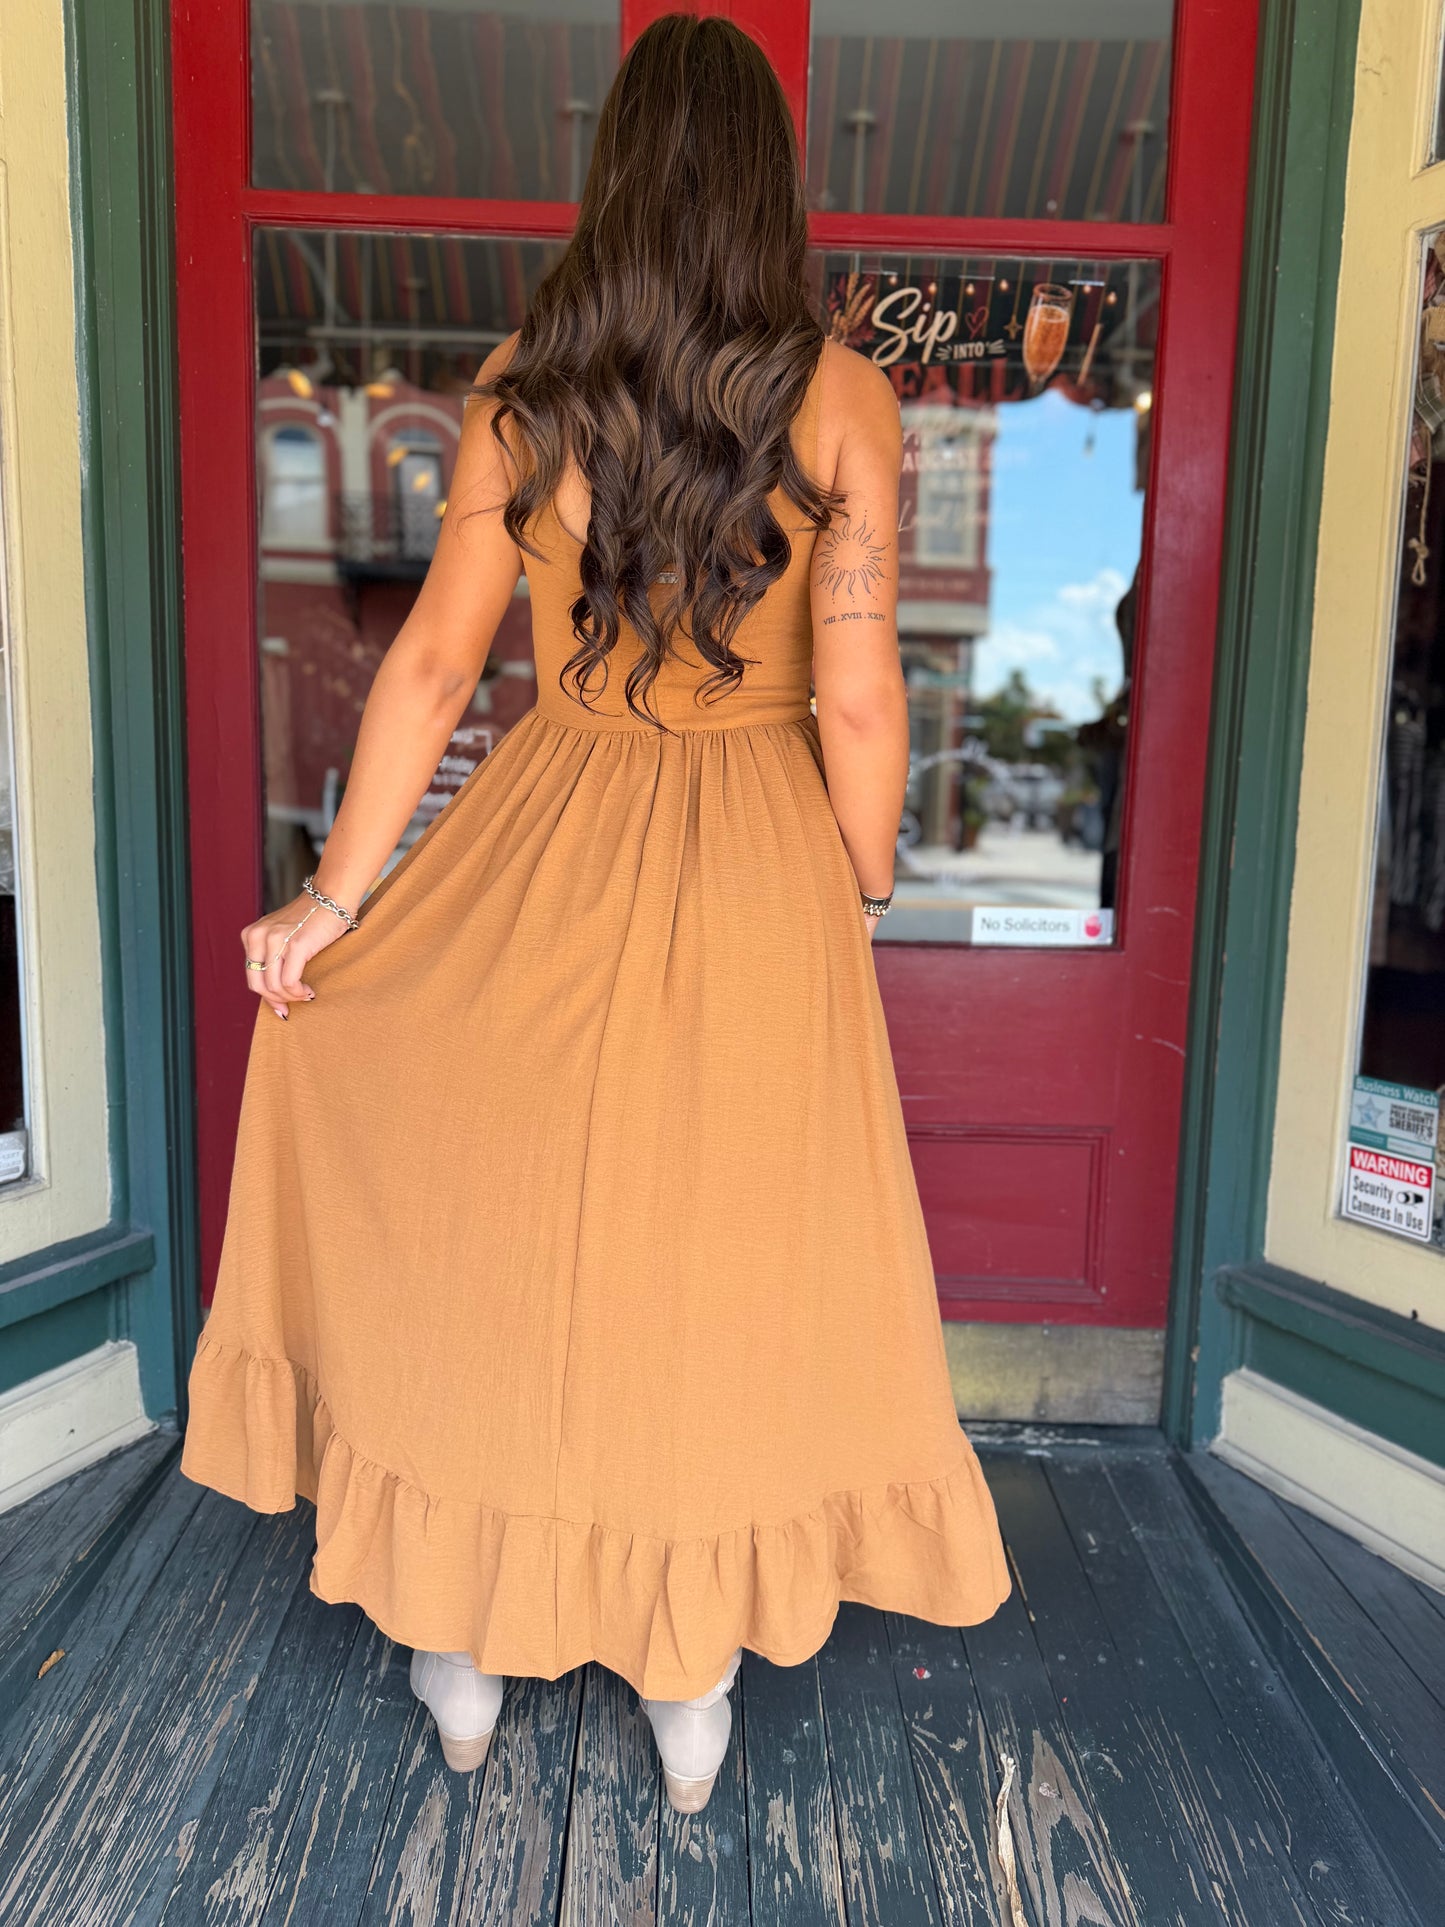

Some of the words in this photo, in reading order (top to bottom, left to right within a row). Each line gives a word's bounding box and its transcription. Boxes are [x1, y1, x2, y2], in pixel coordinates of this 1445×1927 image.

[871, 286, 958, 368] Sip
[952, 341, 985, 360] INTO
[980, 917, 1000, 931] No
[1004, 917, 1071, 932] Solicitors
[1356, 1077, 1401, 1098] Business
[1403, 1087, 1438, 1106] Watch
[1353, 1150, 1429, 1185] WARNING
[1353, 1175, 1393, 1204] Security
[1351, 1195, 1391, 1221] Cameras
[1394, 1207, 1403, 1224] In
[1405, 1210, 1424, 1231] Use
